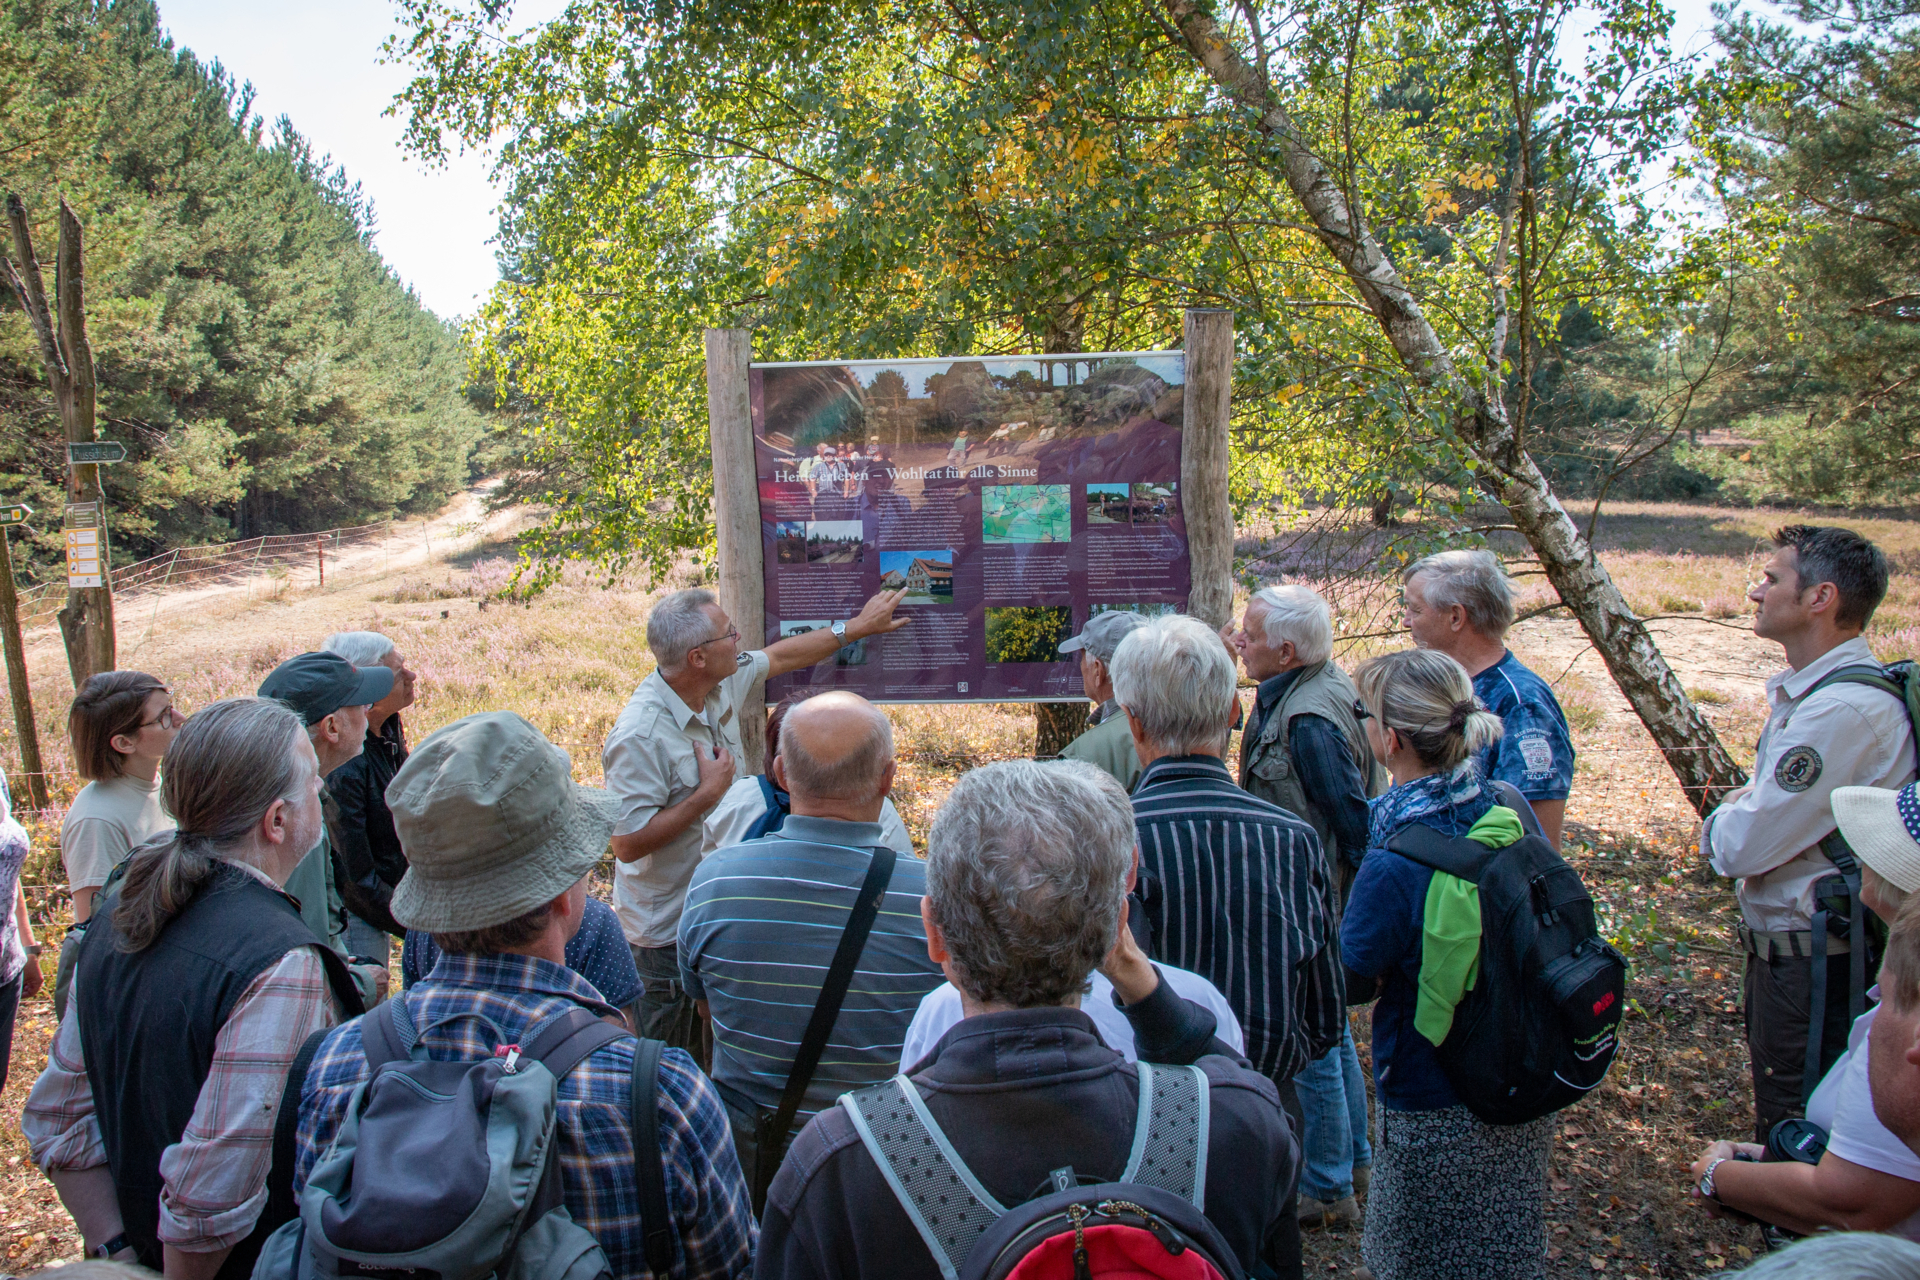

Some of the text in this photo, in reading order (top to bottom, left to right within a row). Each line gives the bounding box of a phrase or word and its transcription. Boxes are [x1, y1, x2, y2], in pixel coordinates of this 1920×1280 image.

[775, 469, 816, 483] Heide
[820, 469, 869, 481] erleben
[886, 466, 942, 480] Wohltat
[945, 465, 966, 479] für
[970, 465, 994, 478] alle
[998, 464, 1038, 478] Sinne
[0, 513, 10, 521] km
